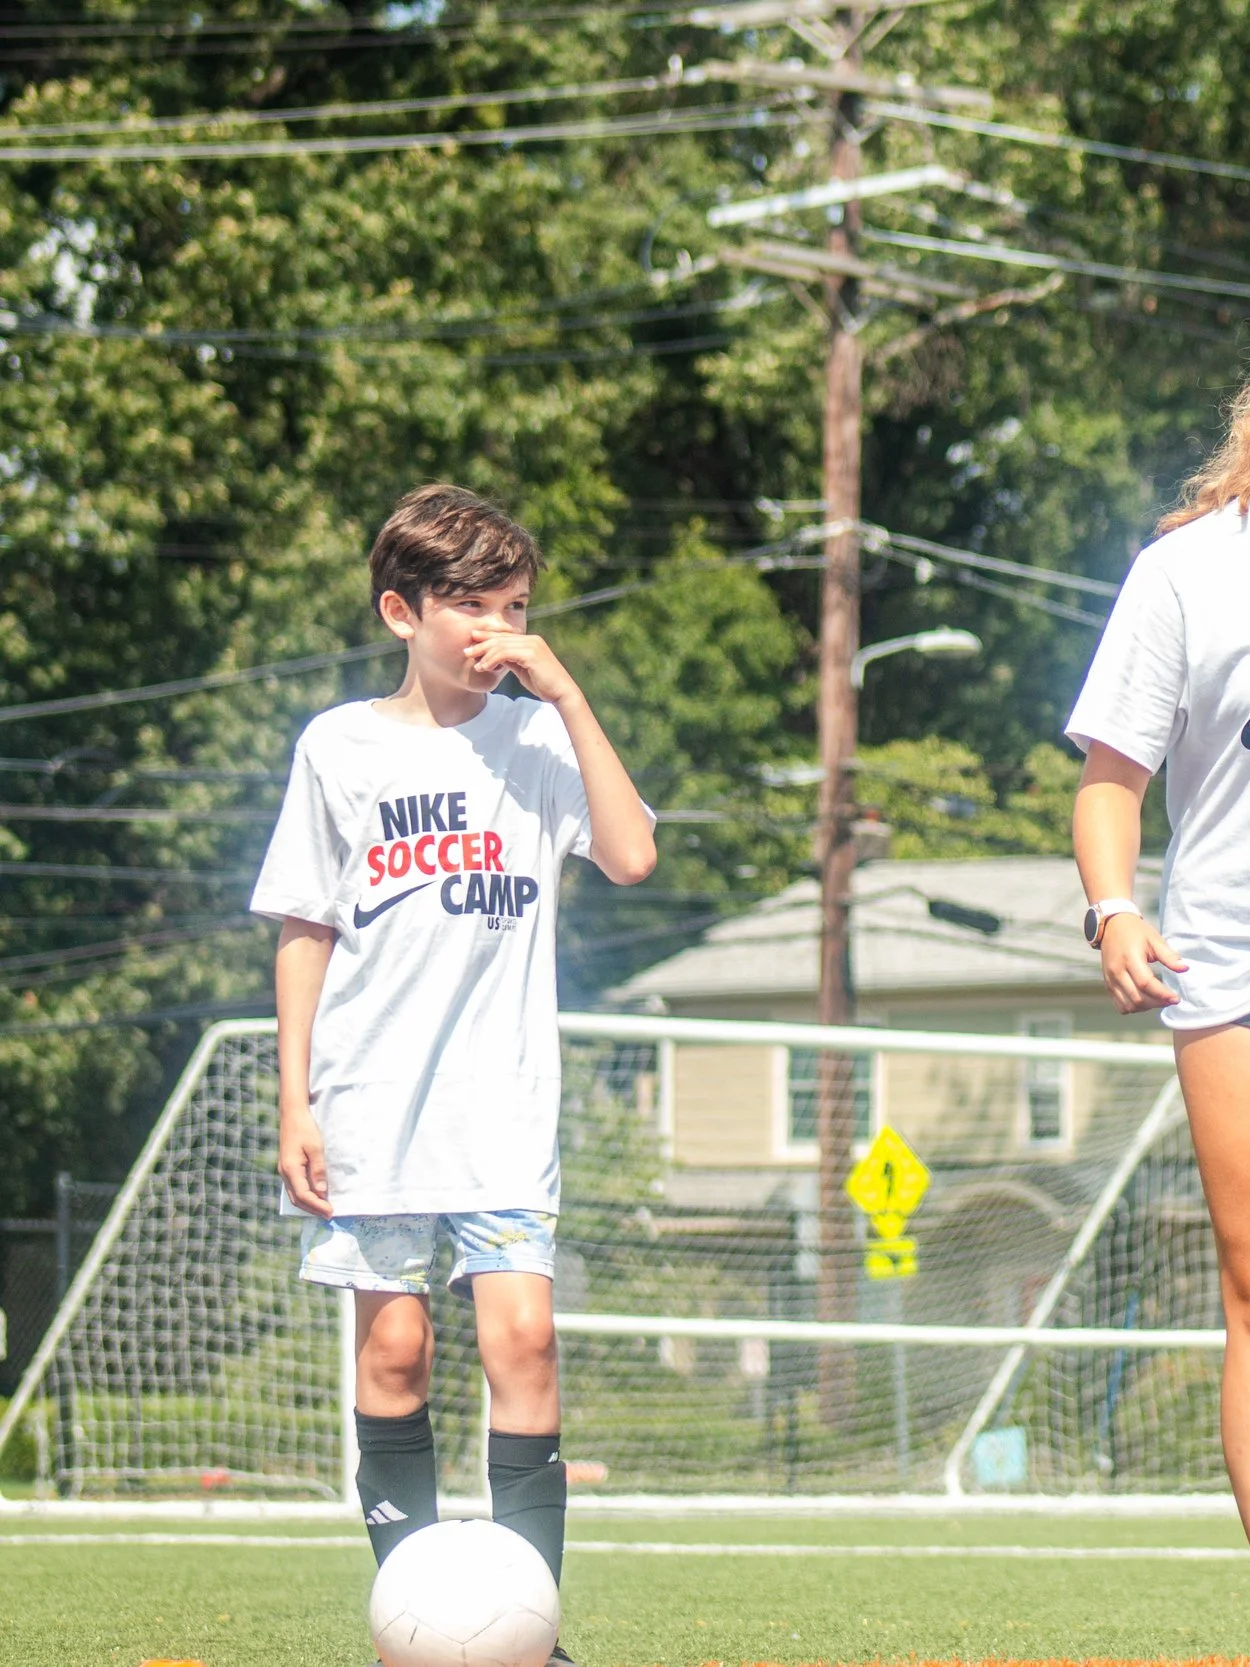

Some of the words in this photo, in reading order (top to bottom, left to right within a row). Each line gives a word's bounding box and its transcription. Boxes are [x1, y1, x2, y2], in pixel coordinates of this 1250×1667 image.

[378, 791, 468, 841] NIKE
[367, 830, 504, 886] SOCCER
[440, 873, 539, 918] CAMP
[487, 916, 500, 930] US
